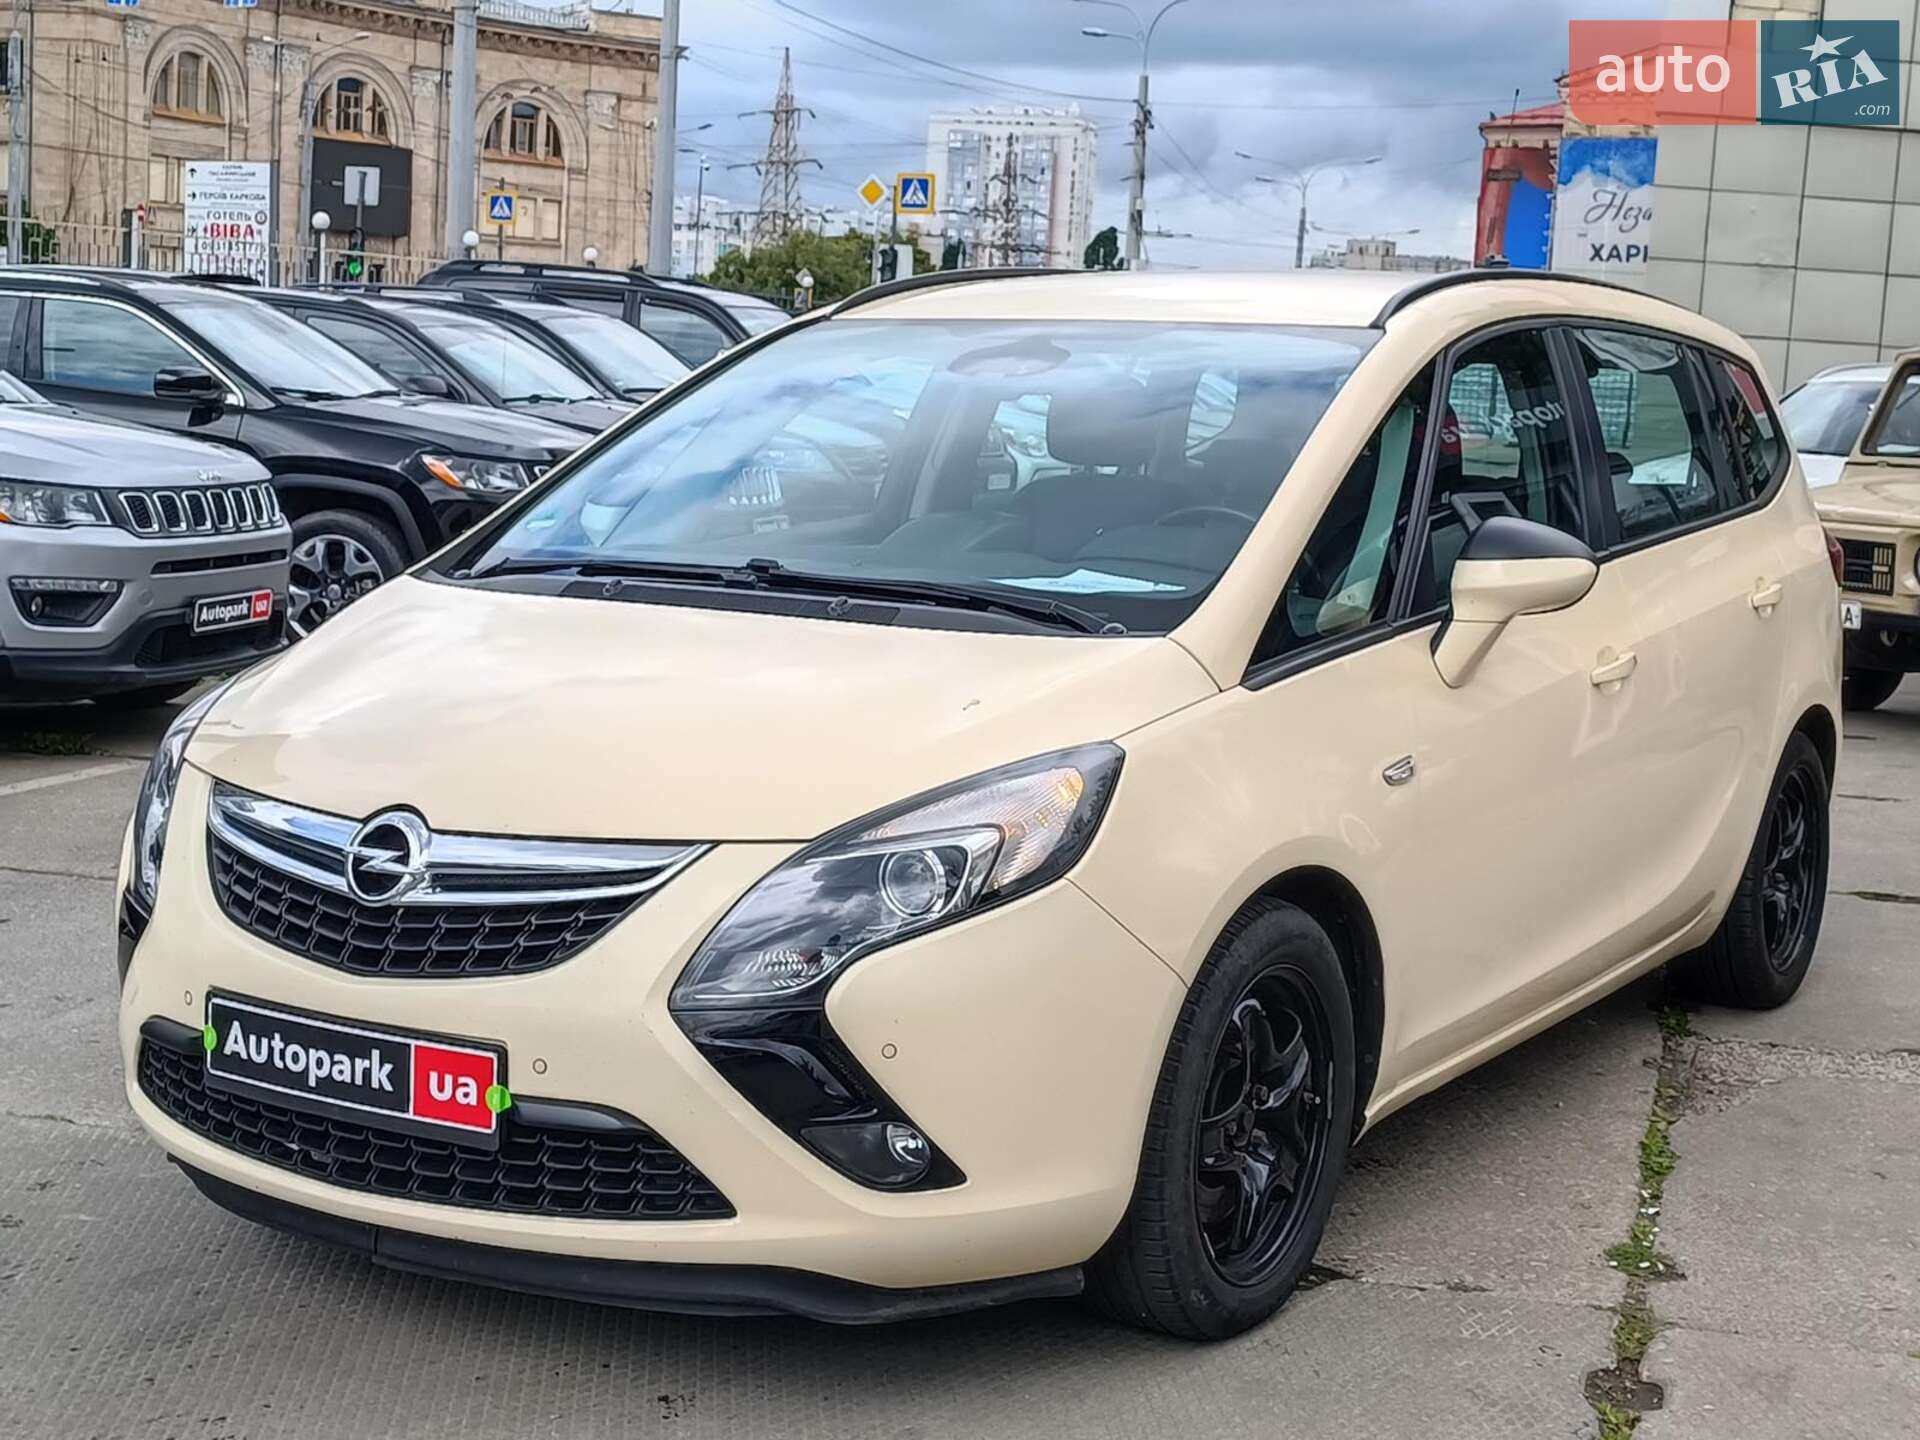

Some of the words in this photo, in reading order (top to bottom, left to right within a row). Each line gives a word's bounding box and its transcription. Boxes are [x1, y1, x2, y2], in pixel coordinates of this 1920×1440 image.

[206, 210, 251, 221] ГОТЕЛЬ
[200, 600, 249, 622] Autopark
[255, 600, 267, 612] ua
[223, 1020, 394, 1091] Autopark
[428, 1071, 478, 1106] ua
